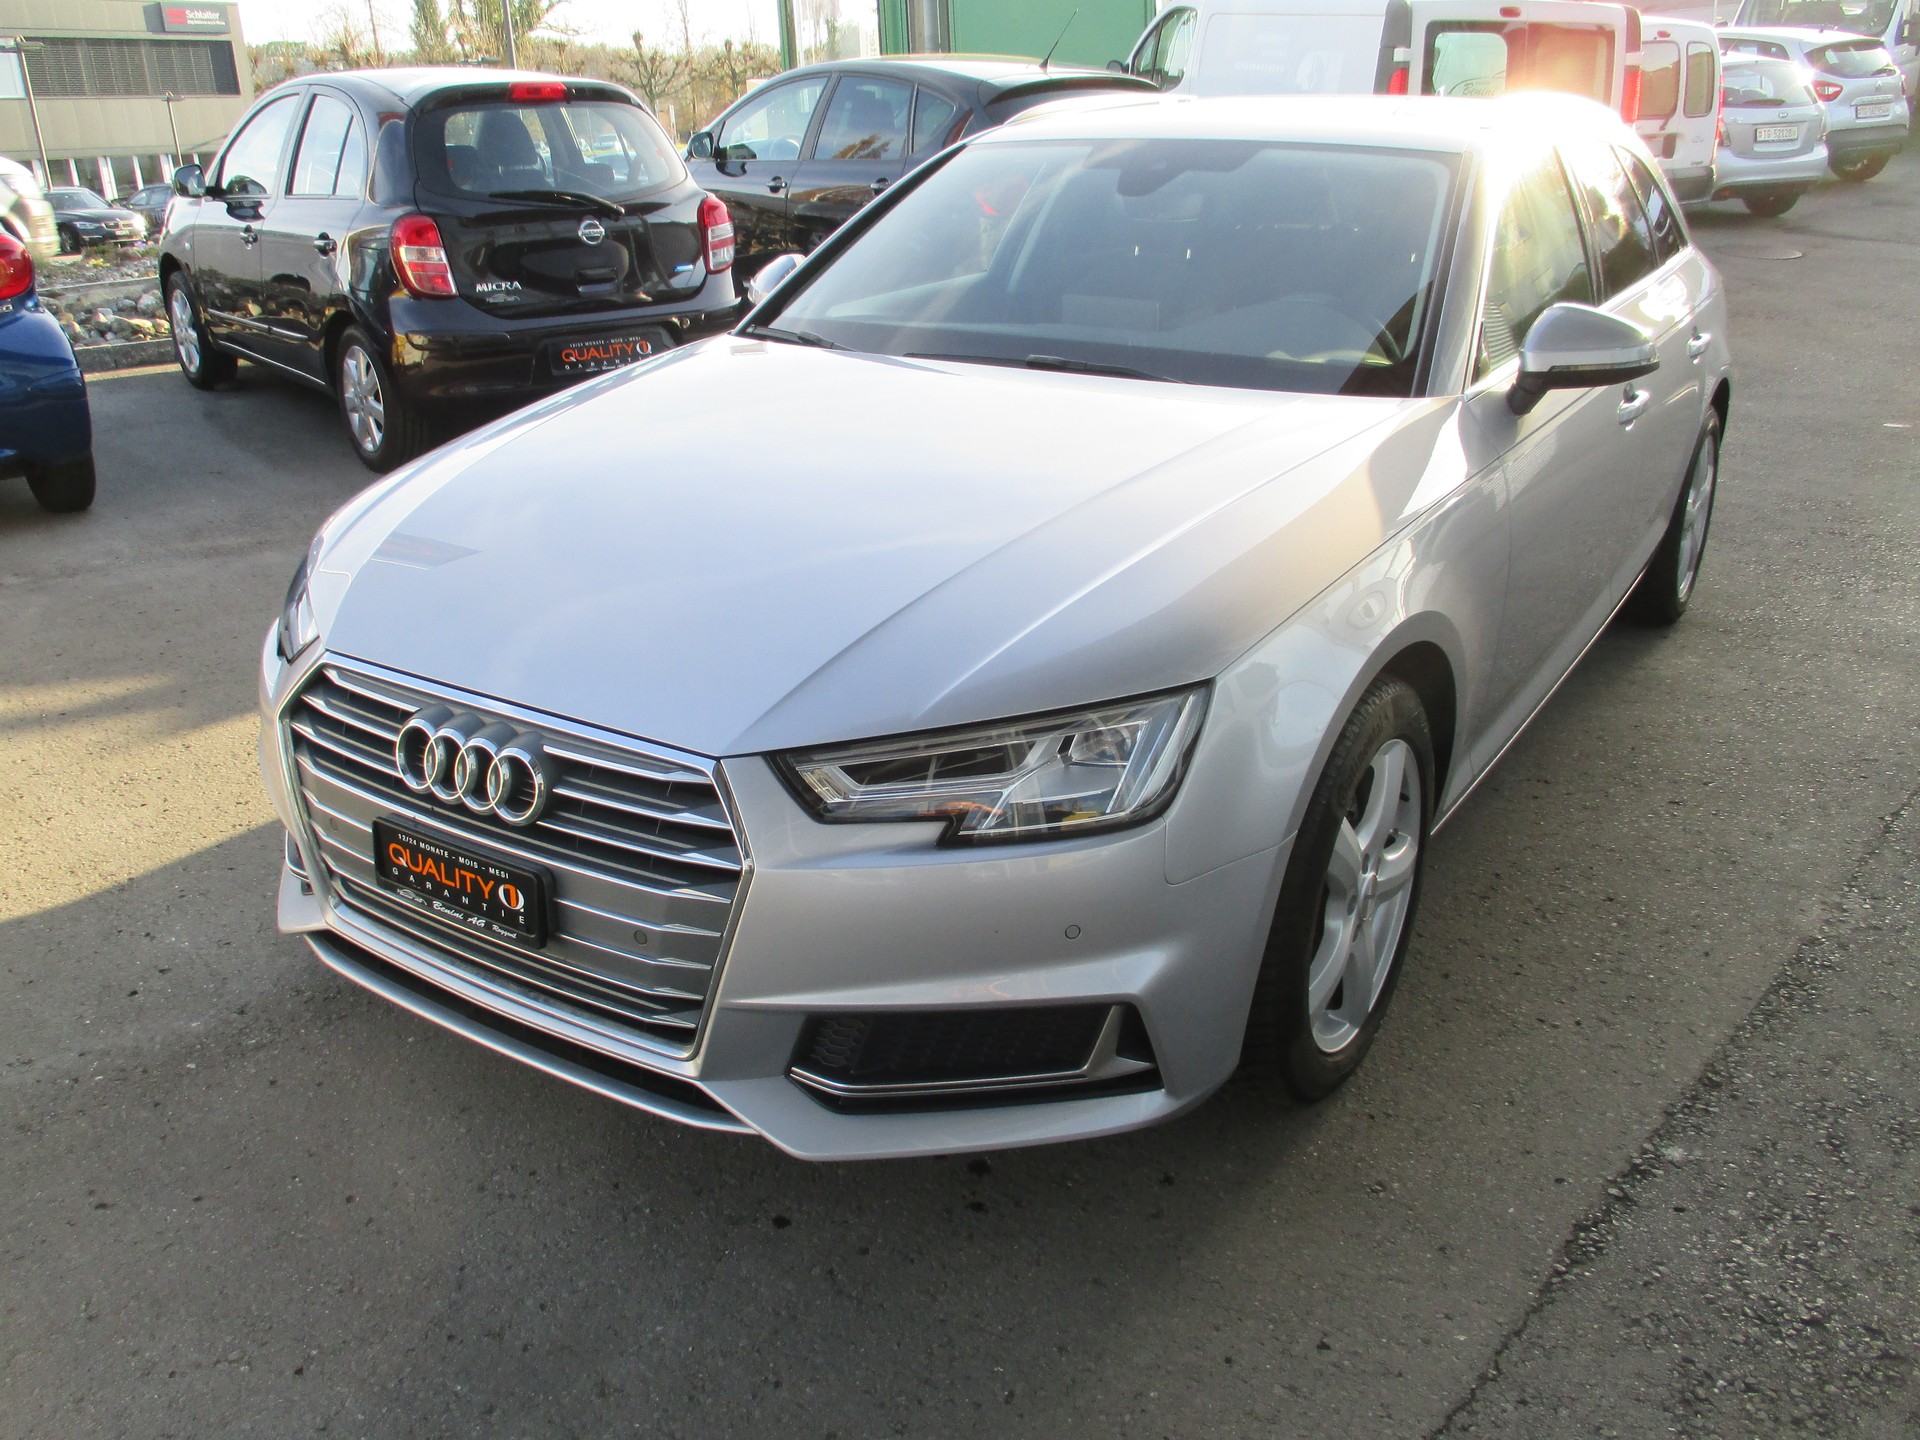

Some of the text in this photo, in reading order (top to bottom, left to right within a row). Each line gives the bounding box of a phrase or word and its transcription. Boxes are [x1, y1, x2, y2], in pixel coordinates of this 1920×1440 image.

[185, 9, 220, 20] Schlatter
[476, 281, 522, 293] MICRA
[561, 342, 635, 362] QUALITY
[388, 842, 495, 900] QUALITY
[398, 833, 417, 846] 12/24
[419, 841, 449, 858] MONATE
[458, 856, 479, 869] MOIS
[488, 866, 510, 880] MESI
[391, 867, 526, 925] GARANTIE
[432, 900, 464, 920] Benini
[467, 916, 487, 929] AG
